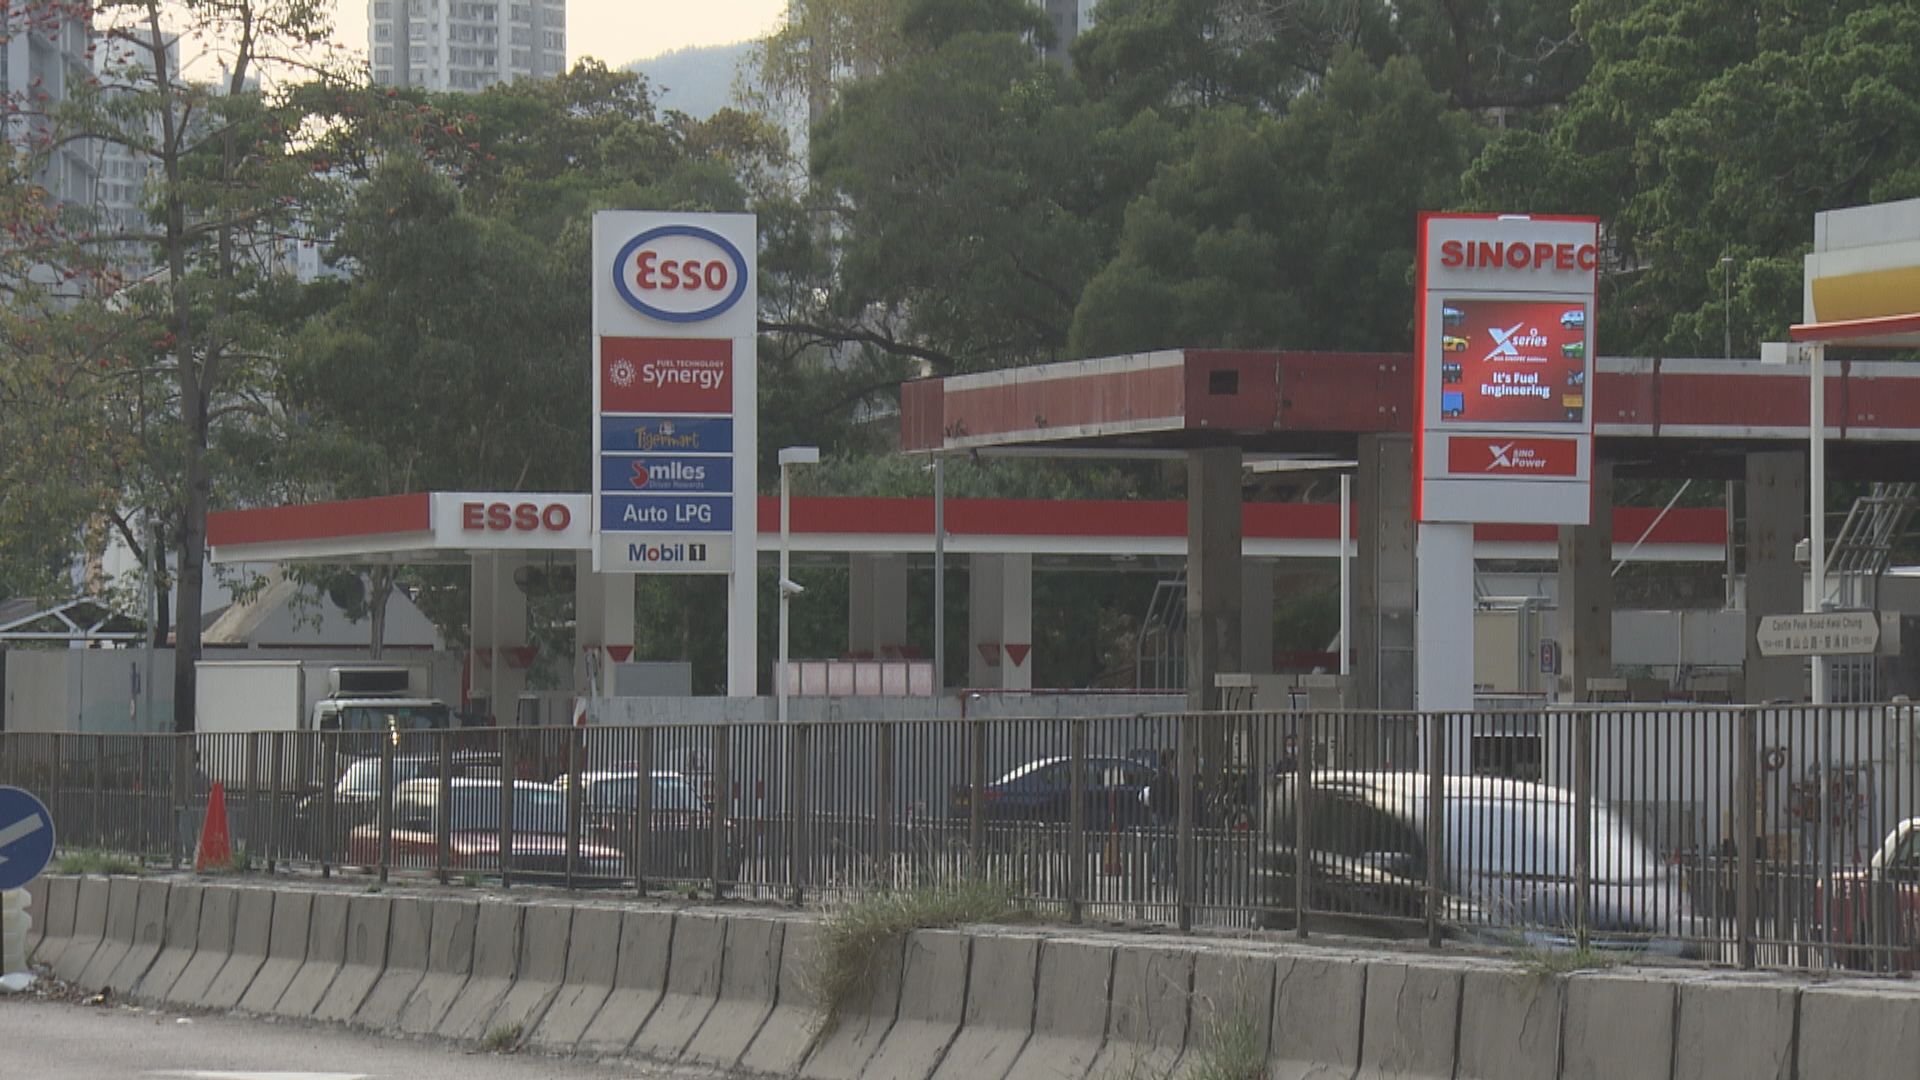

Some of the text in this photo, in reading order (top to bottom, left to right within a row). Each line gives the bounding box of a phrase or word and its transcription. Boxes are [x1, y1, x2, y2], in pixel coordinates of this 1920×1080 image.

[1441, 240, 1598, 271] SINOPEC
[636, 250, 727, 291] Esso
[1512, 328, 1548, 347] series
[677, 360, 724, 368] TECHNOLOGY
[643, 363, 724, 389] Synergy
[1493, 372, 1538, 384] It's Fuel
[1481, 384, 1550, 399] Engineering
[1512, 448, 1535, 458] SINO
[1511, 458, 1546, 469] Power
[463, 502, 571, 531] ESSO
[623, 503, 711, 522] Auto LPG
[629, 543, 706, 561] Mobil 1
[1773, 620, 1791, 631] Castle
[1843, 617, 1862, 629] Chung
